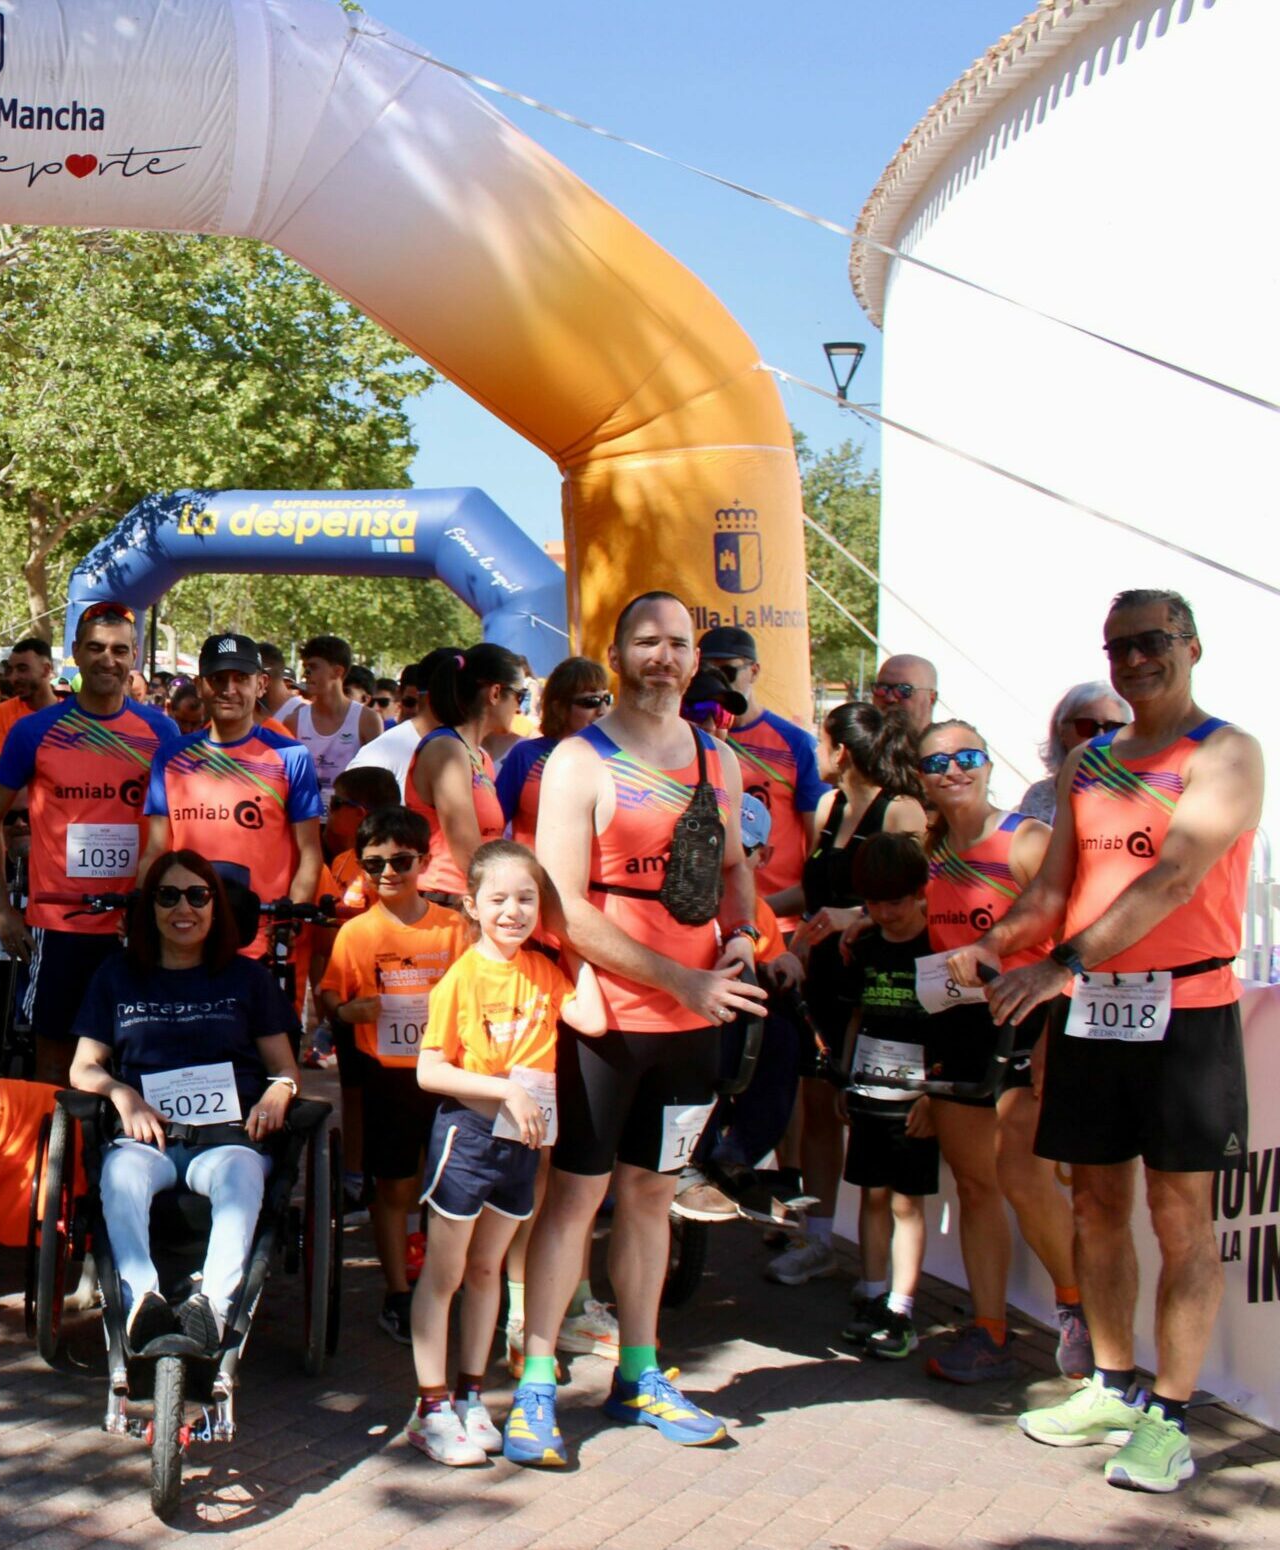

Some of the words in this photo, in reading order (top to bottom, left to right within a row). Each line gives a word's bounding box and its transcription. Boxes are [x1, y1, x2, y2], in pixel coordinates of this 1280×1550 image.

[272, 499, 408, 510] SUPERMERCADOS
[177, 503, 219, 535] La
[228, 504, 419, 545] despensa
[54, 782, 117, 800] amiab
[173, 802, 231, 821] amiab
[1080, 834, 1124, 851] amiab
[76, 848, 131, 868] 1039
[91, 869, 117, 877] DAVID
[1083, 1001, 1157, 1029] 1018
[159, 1091, 228, 1120] 5022
[1221, 1229, 1242, 1263] LA
